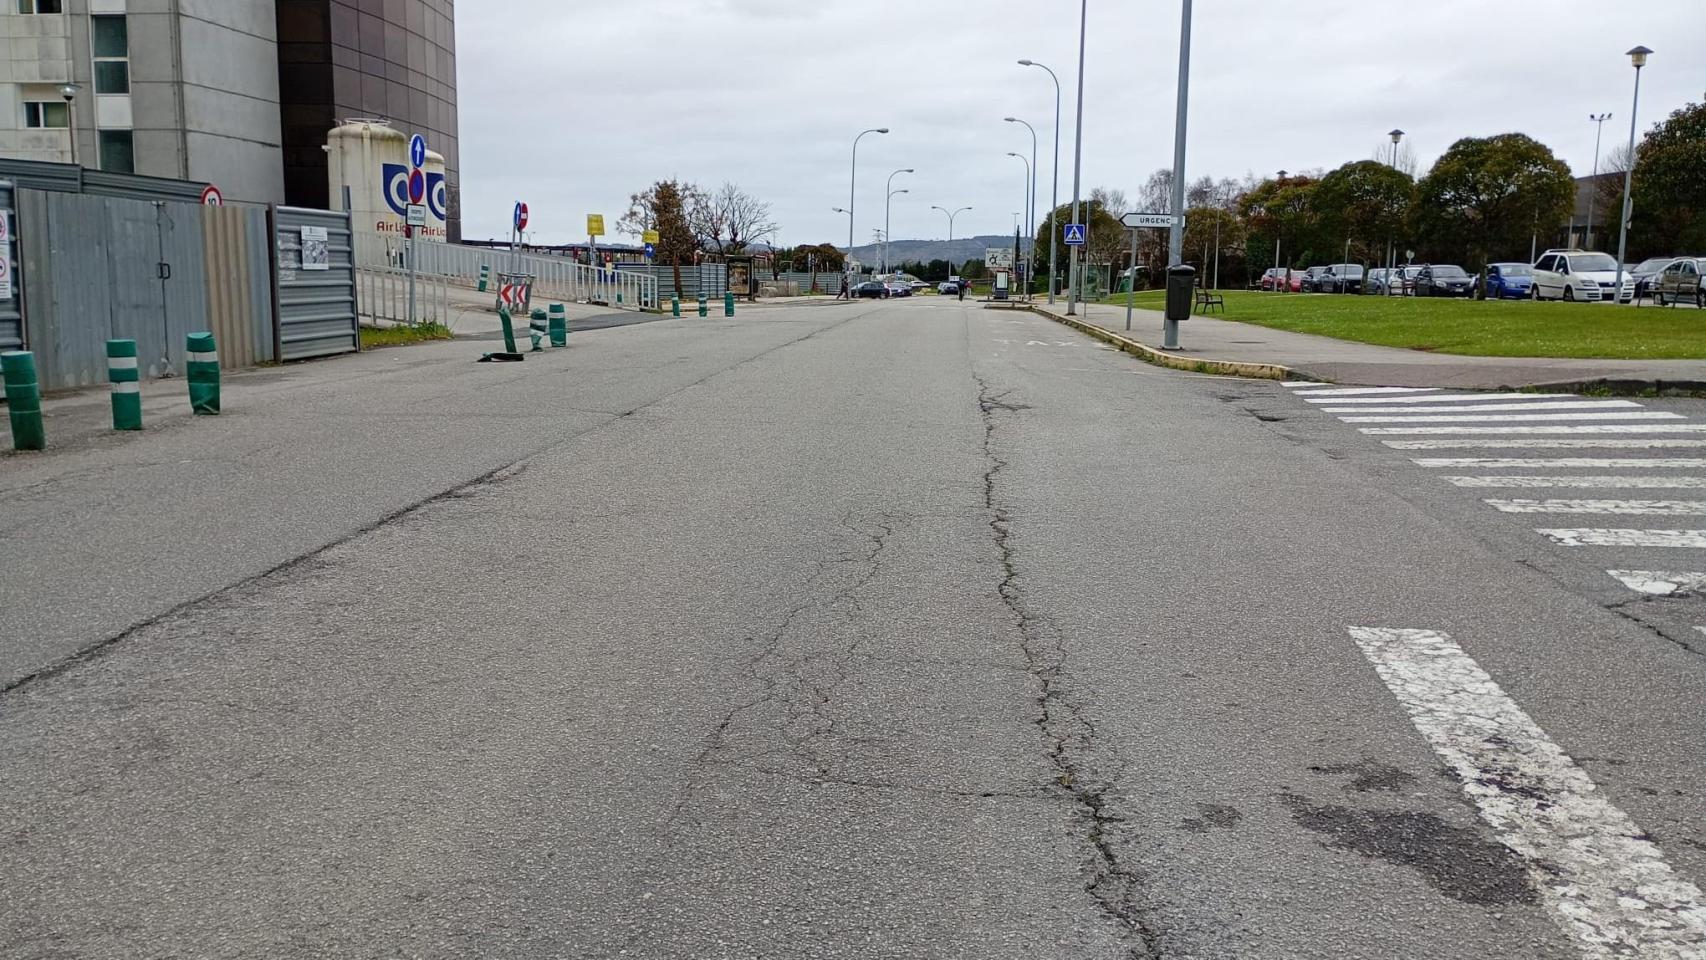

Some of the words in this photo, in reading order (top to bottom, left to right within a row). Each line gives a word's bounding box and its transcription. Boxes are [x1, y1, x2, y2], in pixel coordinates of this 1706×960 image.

[1139, 216, 1171, 224] URGENC
[376, 221, 393, 232] Air
[421, 226, 436, 237] Air
